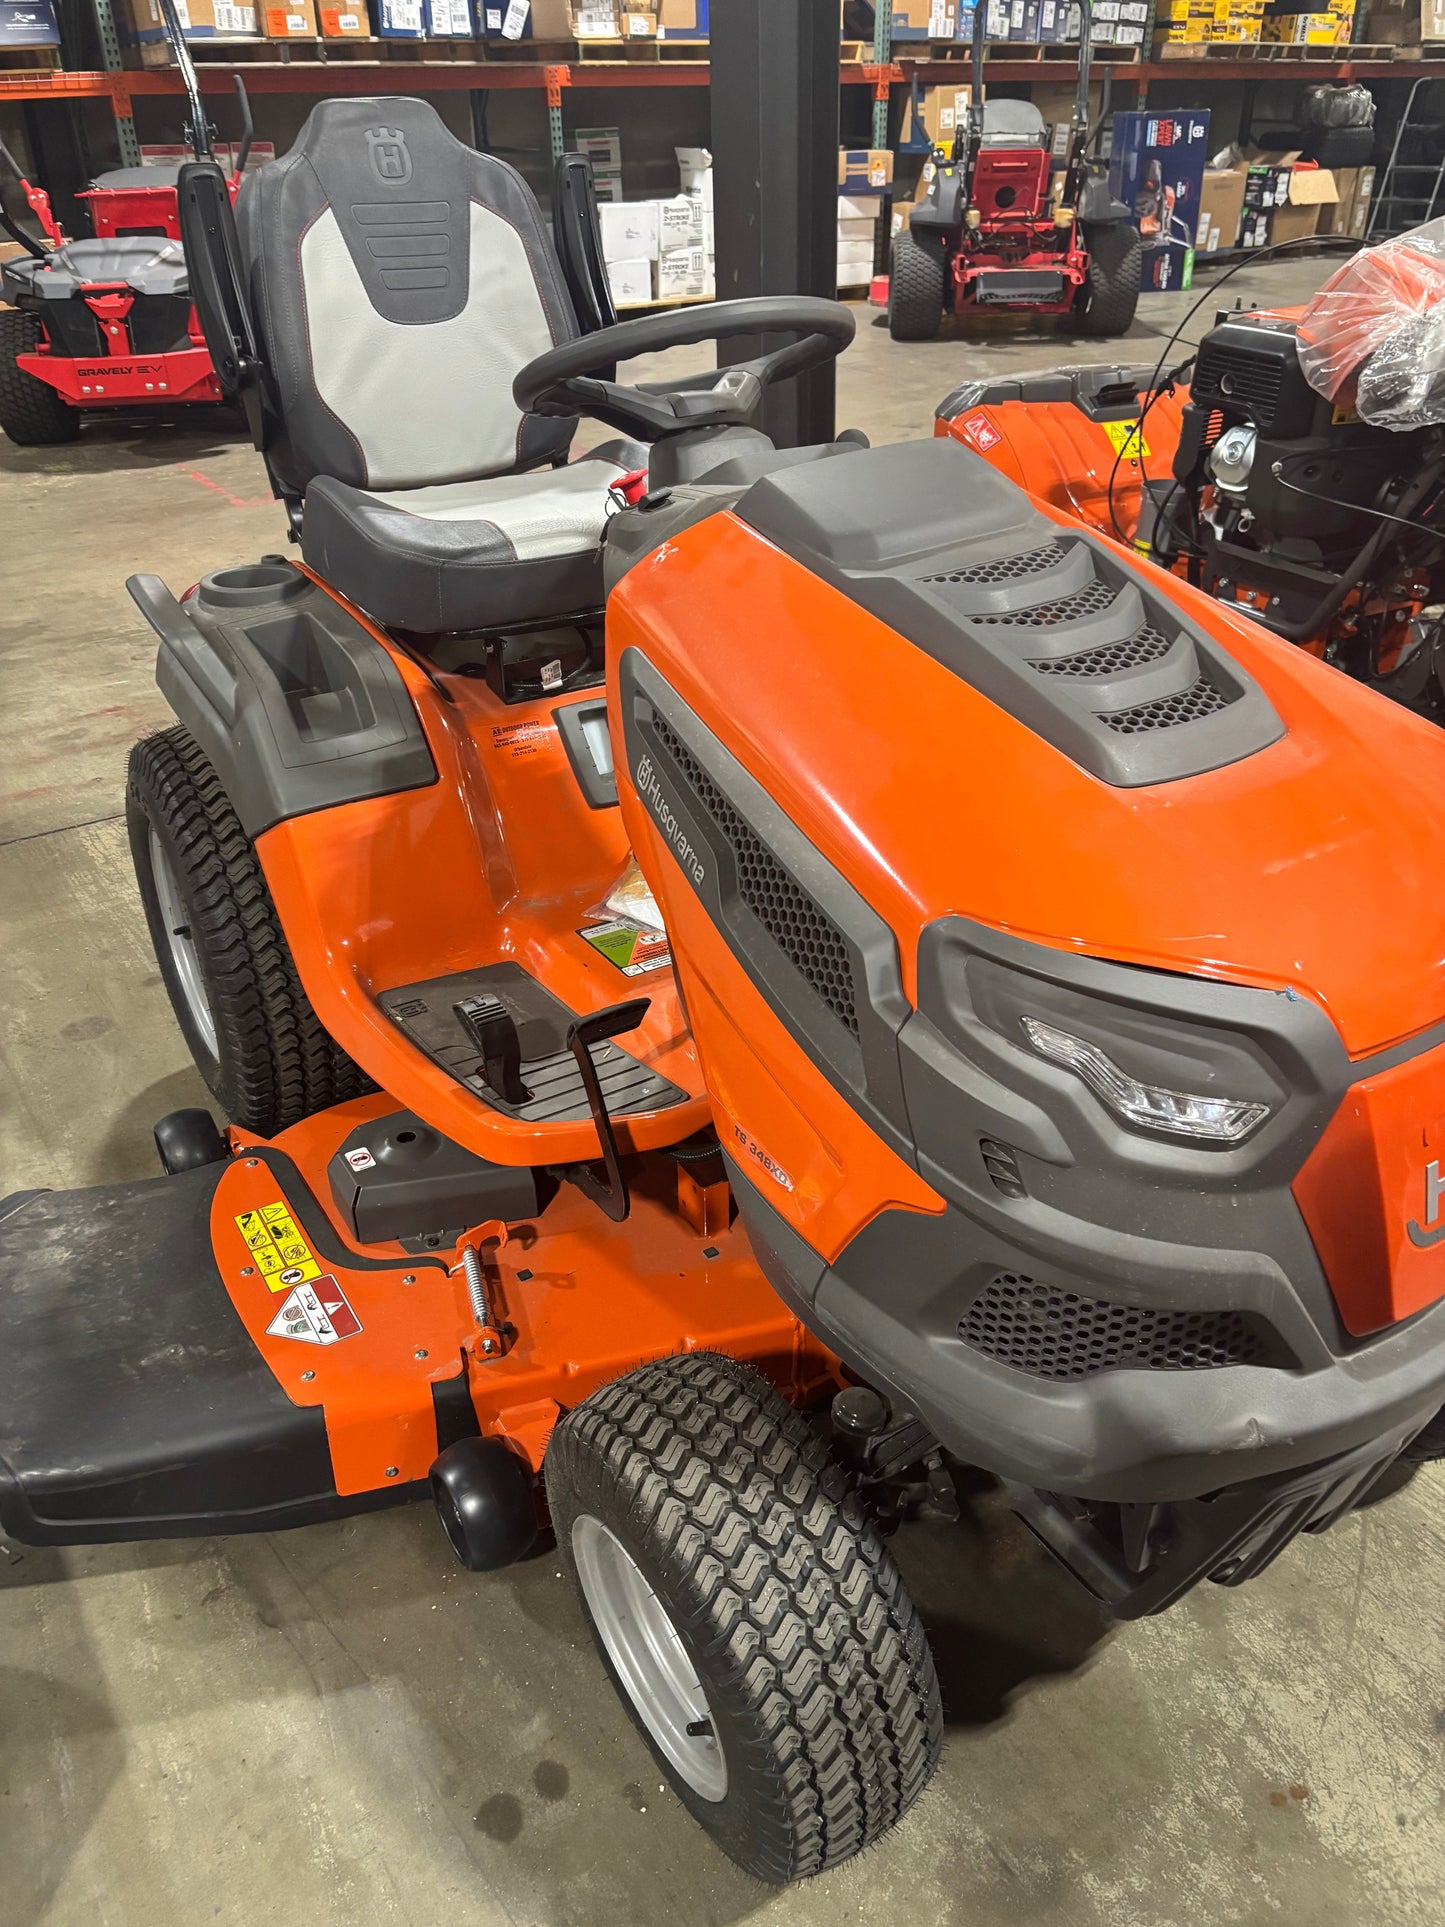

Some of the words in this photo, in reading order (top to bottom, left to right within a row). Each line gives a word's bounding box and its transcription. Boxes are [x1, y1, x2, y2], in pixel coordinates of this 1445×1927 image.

[77, 366, 133, 377] GRAVELY
[136, 365, 162, 374] EV
[647, 774, 705, 886] Husqvarna
[734, 1125, 748, 1145] TS
[749, 1142, 788, 1185] 348XD
